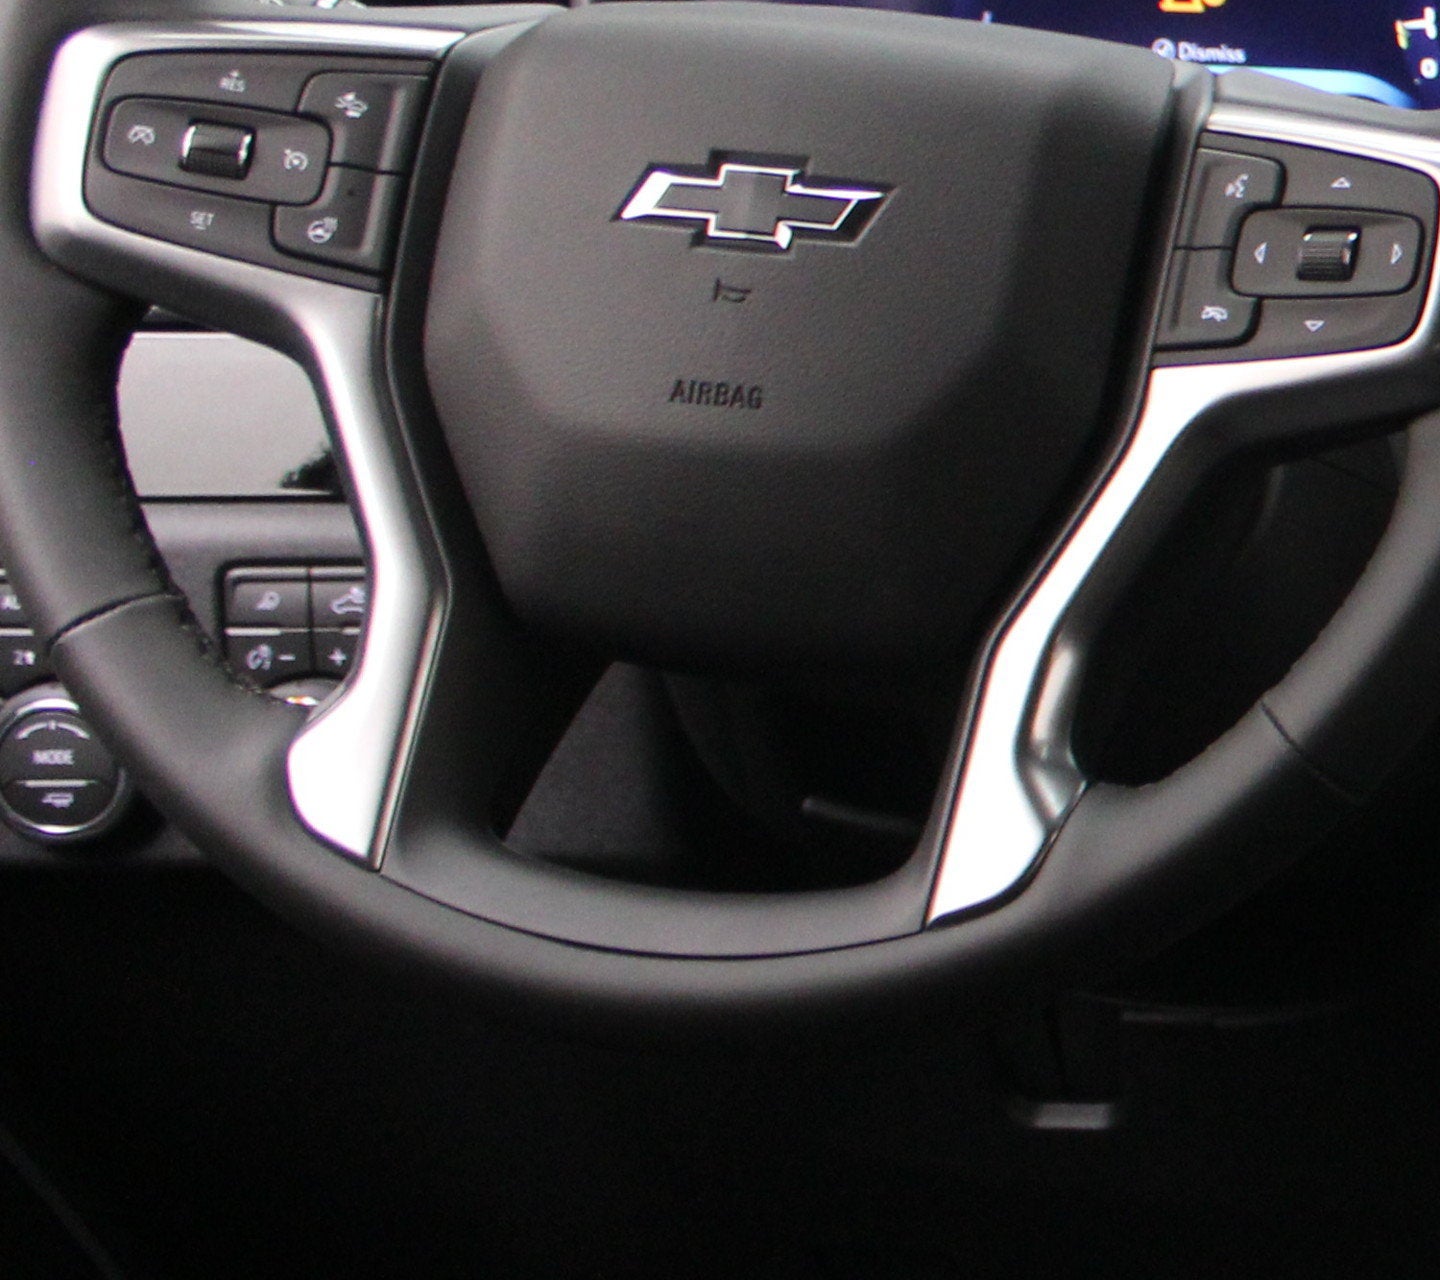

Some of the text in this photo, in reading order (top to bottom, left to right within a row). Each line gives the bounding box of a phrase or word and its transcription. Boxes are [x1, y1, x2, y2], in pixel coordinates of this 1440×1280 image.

[1178, 41, 1247, 64] Dismiss
[219, 75, 246, 93] RES
[189, 210, 215, 225] SET
[668, 379, 763, 409] AIRBAG
[32, 749, 74, 765] MODE
